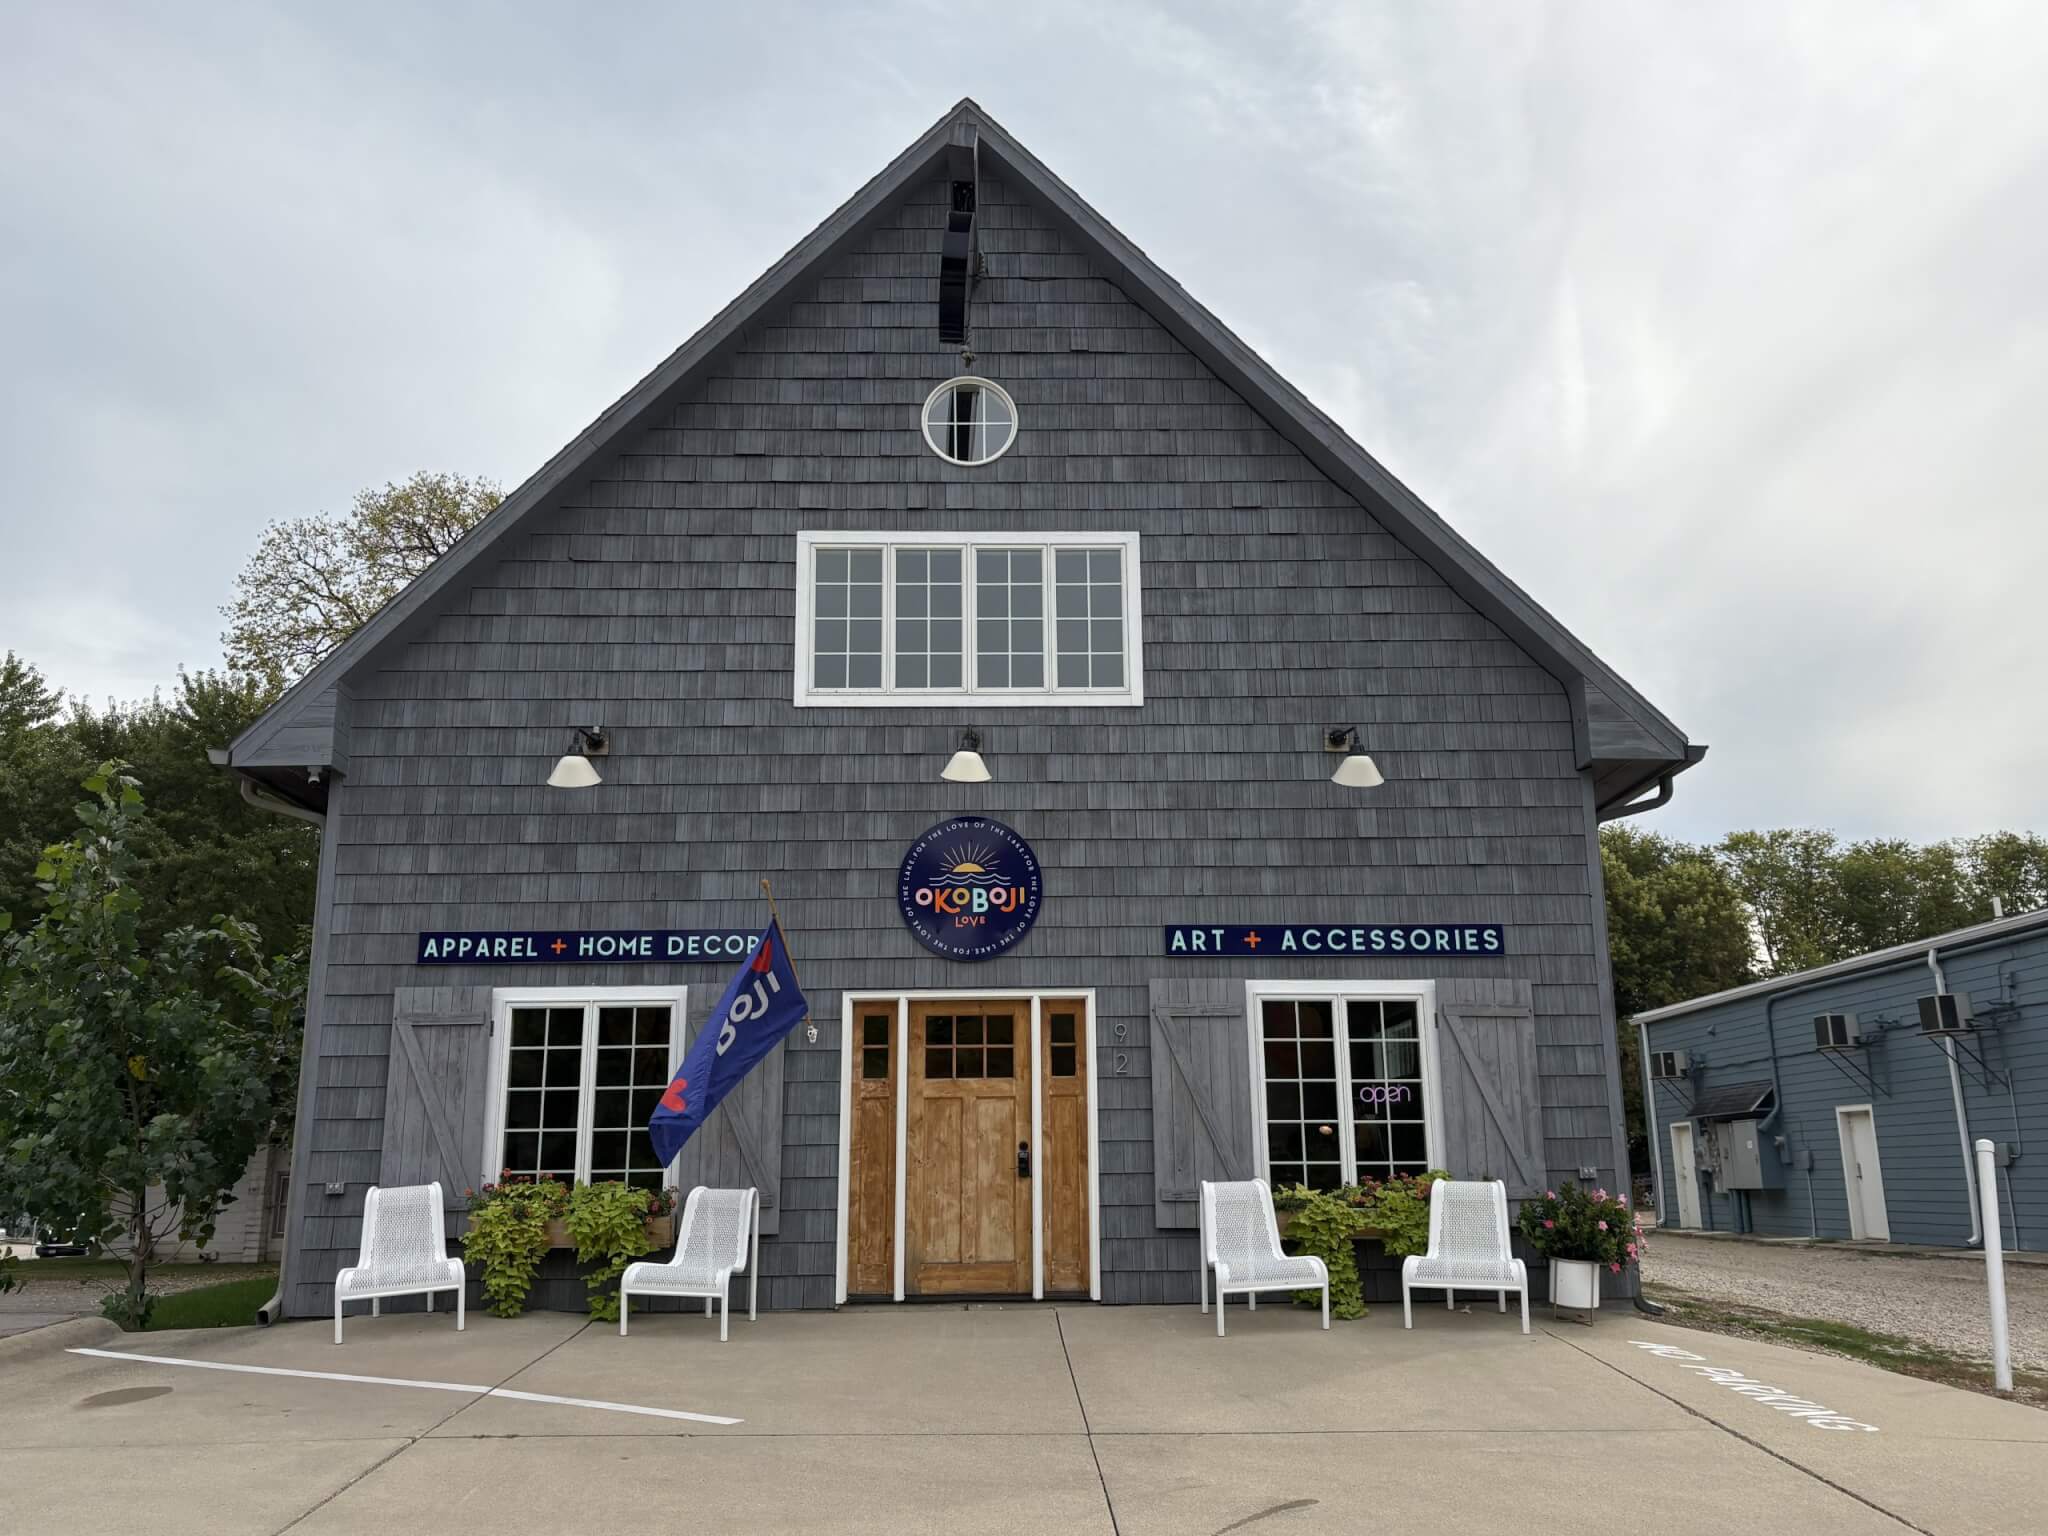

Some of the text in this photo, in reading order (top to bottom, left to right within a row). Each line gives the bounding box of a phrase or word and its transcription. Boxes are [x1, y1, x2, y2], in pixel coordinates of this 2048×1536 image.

[927, 829, 943, 841] THE
[946, 821, 969, 832] LOVE
[990, 825, 1005, 836] THE
[1023, 855, 1035, 871] FOR
[902, 885, 910, 901] THE
[1030, 876, 1038, 891] THE
[915, 886, 1025, 914] OKOBOJI
[1024, 896, 1036, 919] LOVE
[912, 919, 932, 940] LOVE
[955, 915, 987, 928] LOVE
[1016, 921, 1026, 932] OF
[424, 937, 538, 957] APPAREL
[579, 936, 653, 956] HOME
[933, 939, 948, 951] THE
[1171, 929, 1225, 951] ART
[1281, 928, 1499, 951] ACCESSORIES
[1360, 1086, 1411, 1114] open
[1627, 1340, 1881, 1432] NO PARKING
